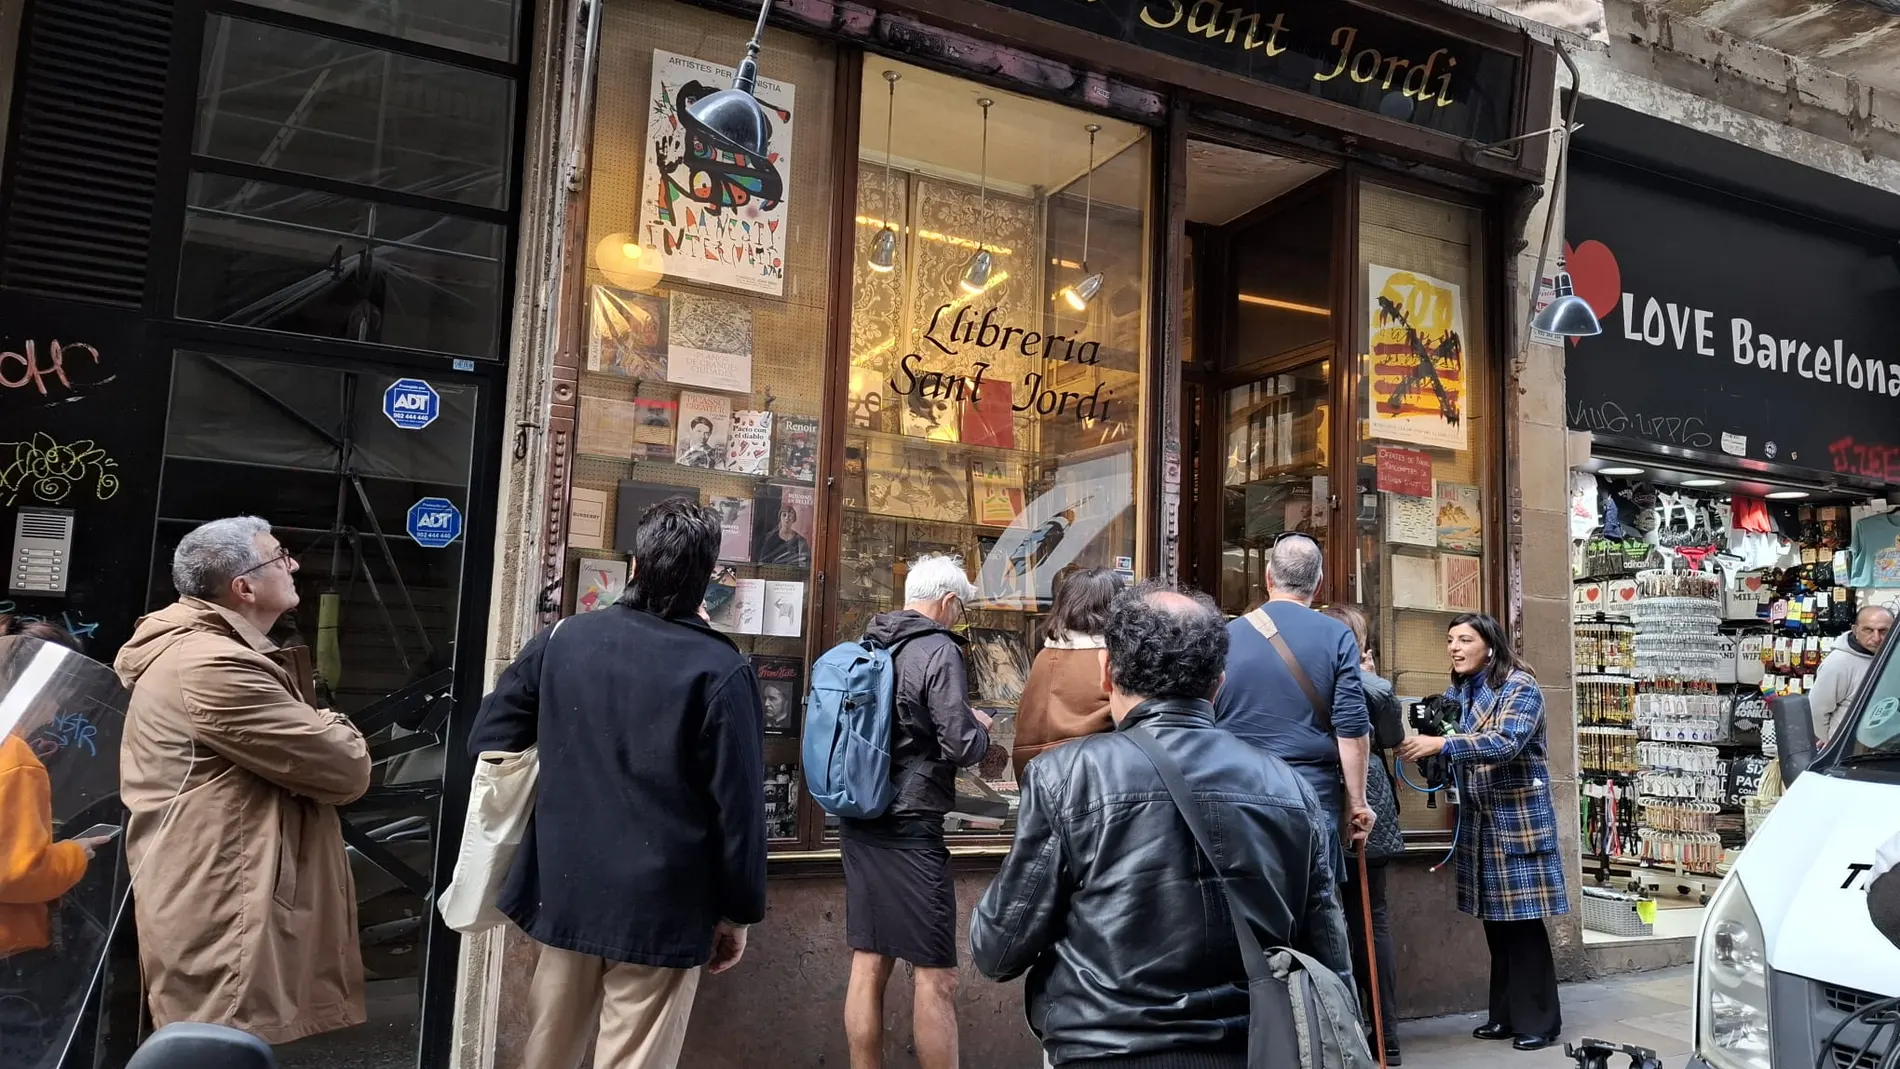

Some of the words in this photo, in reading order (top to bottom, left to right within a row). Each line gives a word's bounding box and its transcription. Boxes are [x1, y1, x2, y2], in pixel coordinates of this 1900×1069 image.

[668, 56, 712, 74] ARTISTES
[715, 67, 733, 80] PER
[1313, 26, 1459, 107] Jordi
[922, 303, 1101, 366] Llibreria
[1621, 292, 1715, 357] LOVE
[1731, 317, 1900, 398] Barcelona
[890, 353, 990, 404] Sant
[1012, 372, 1114, 423] Jordi
[395, 393, 430, 411] ADT
[785, 420, 818, 433] Renoir
[417, 512, 453, 529] ADT
[1735, 577, 1745, 593] I
[1576, 588, 1584, 604] I
[1609, 588, 1618, 604] I
